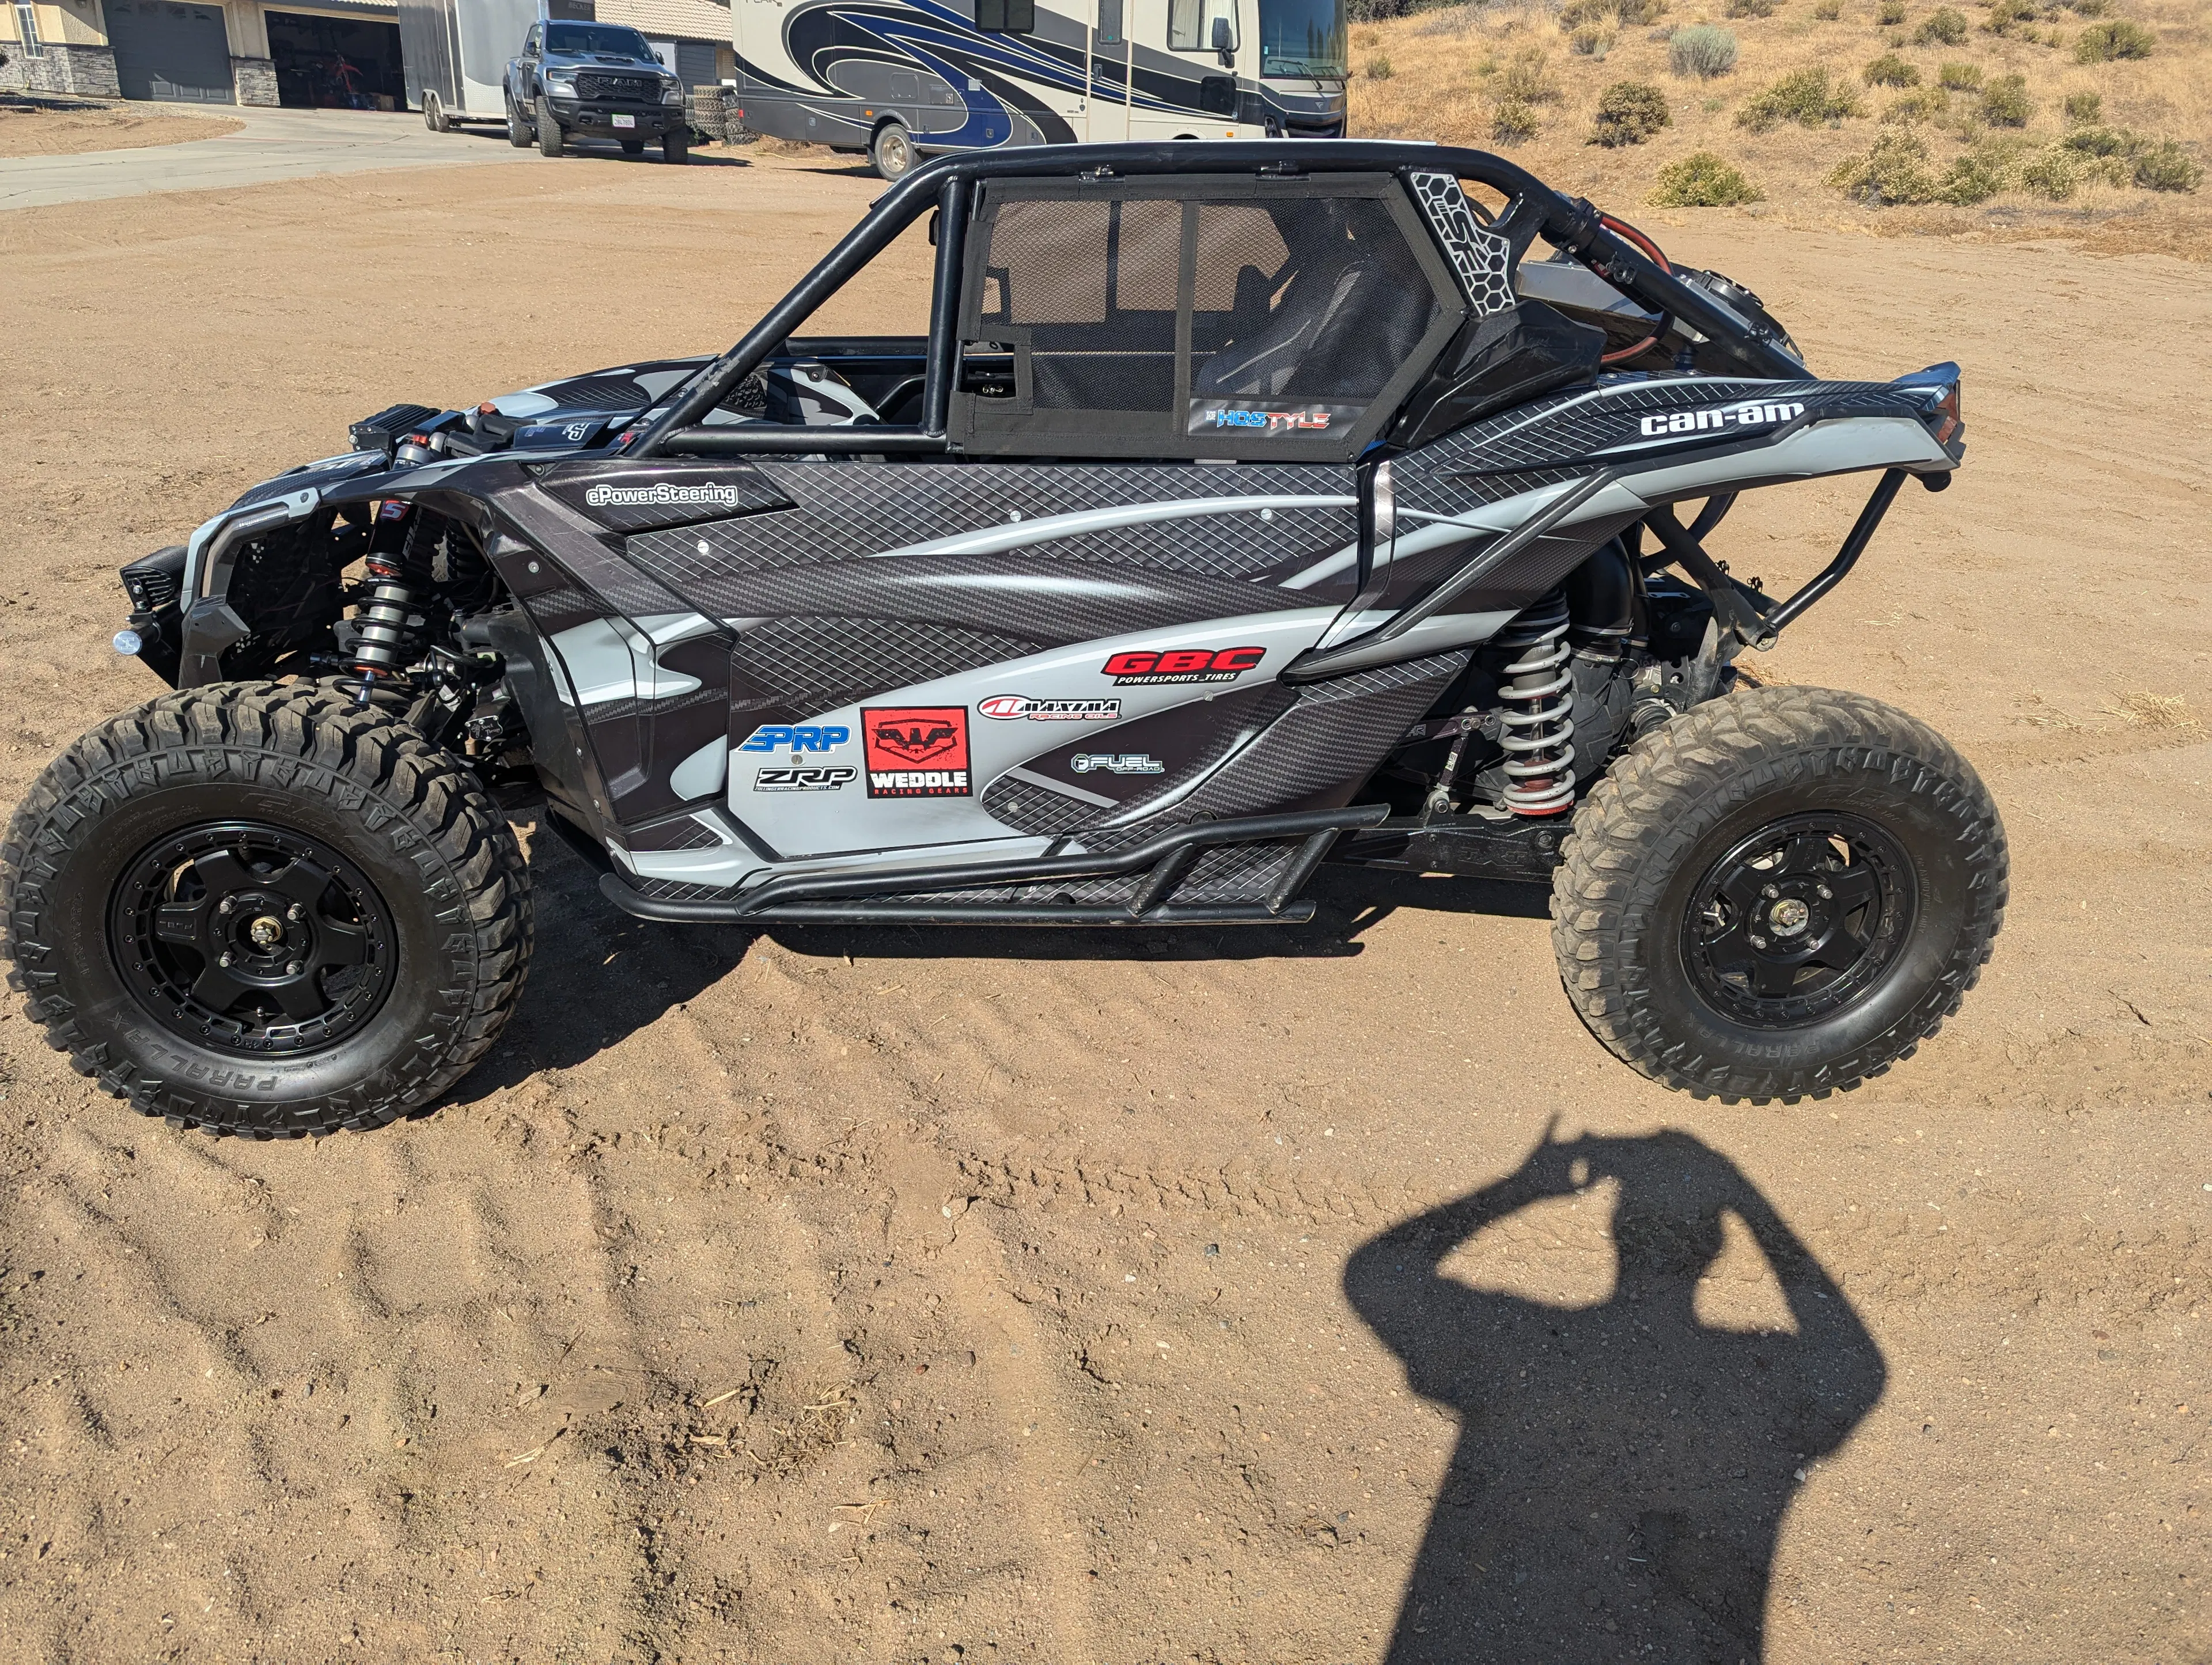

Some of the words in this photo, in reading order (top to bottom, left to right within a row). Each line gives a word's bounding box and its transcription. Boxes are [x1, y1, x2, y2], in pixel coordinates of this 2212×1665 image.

[1217, 409, 1331, 430] HOSTYLE
[1641, 403, 1804, 436] can-am
[588, 483, 737, 505] ePowerSteering
[1105, 648, 1264, 674] GBC
[1117, 674, 1198, 684] POWERSPORTS
[1205, 673, 1236, 681] TIRES
[1017, 700, 1120, 714] MAXIMA
[740, 725, 851, 752] PRP
[1090, 757, 1160, 767] FUEL
[758, 768, 855, 787] ZRP
[870, 772, 967, 788] WEDDLE
[1682, 1011, 1821, 1059] PARALLAX
[106, 1011, 278, 1091] PARALLAX
